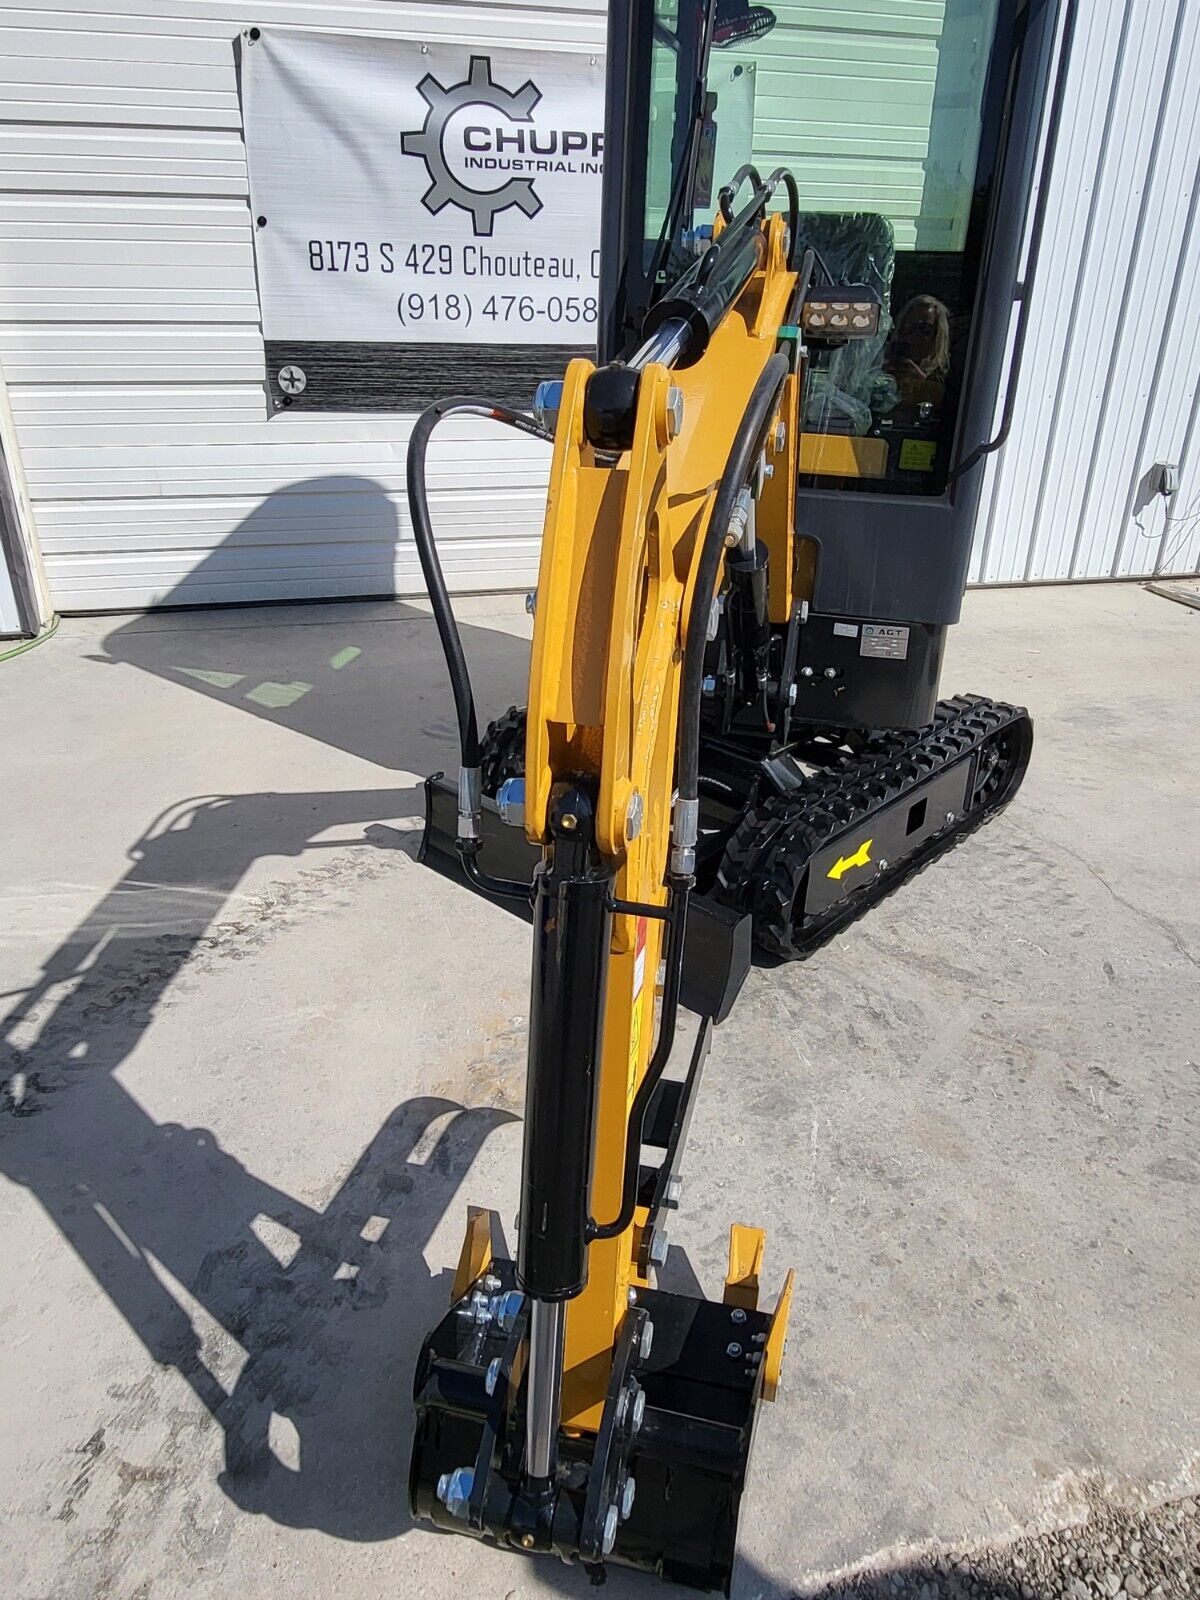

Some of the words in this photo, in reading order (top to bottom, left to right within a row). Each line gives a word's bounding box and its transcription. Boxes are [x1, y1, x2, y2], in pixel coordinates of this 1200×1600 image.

[464, 157, 577, 173] INDUSTRIAL
[581, 162, 603, 174] IN
[308, 240, 370, 273] 8173
[380, 243, 394, 273] S
[405, 243, 453, 275] 429
[463, 245, 581, 282] Chouteau,
[397, 292, 472, 328] (918)
